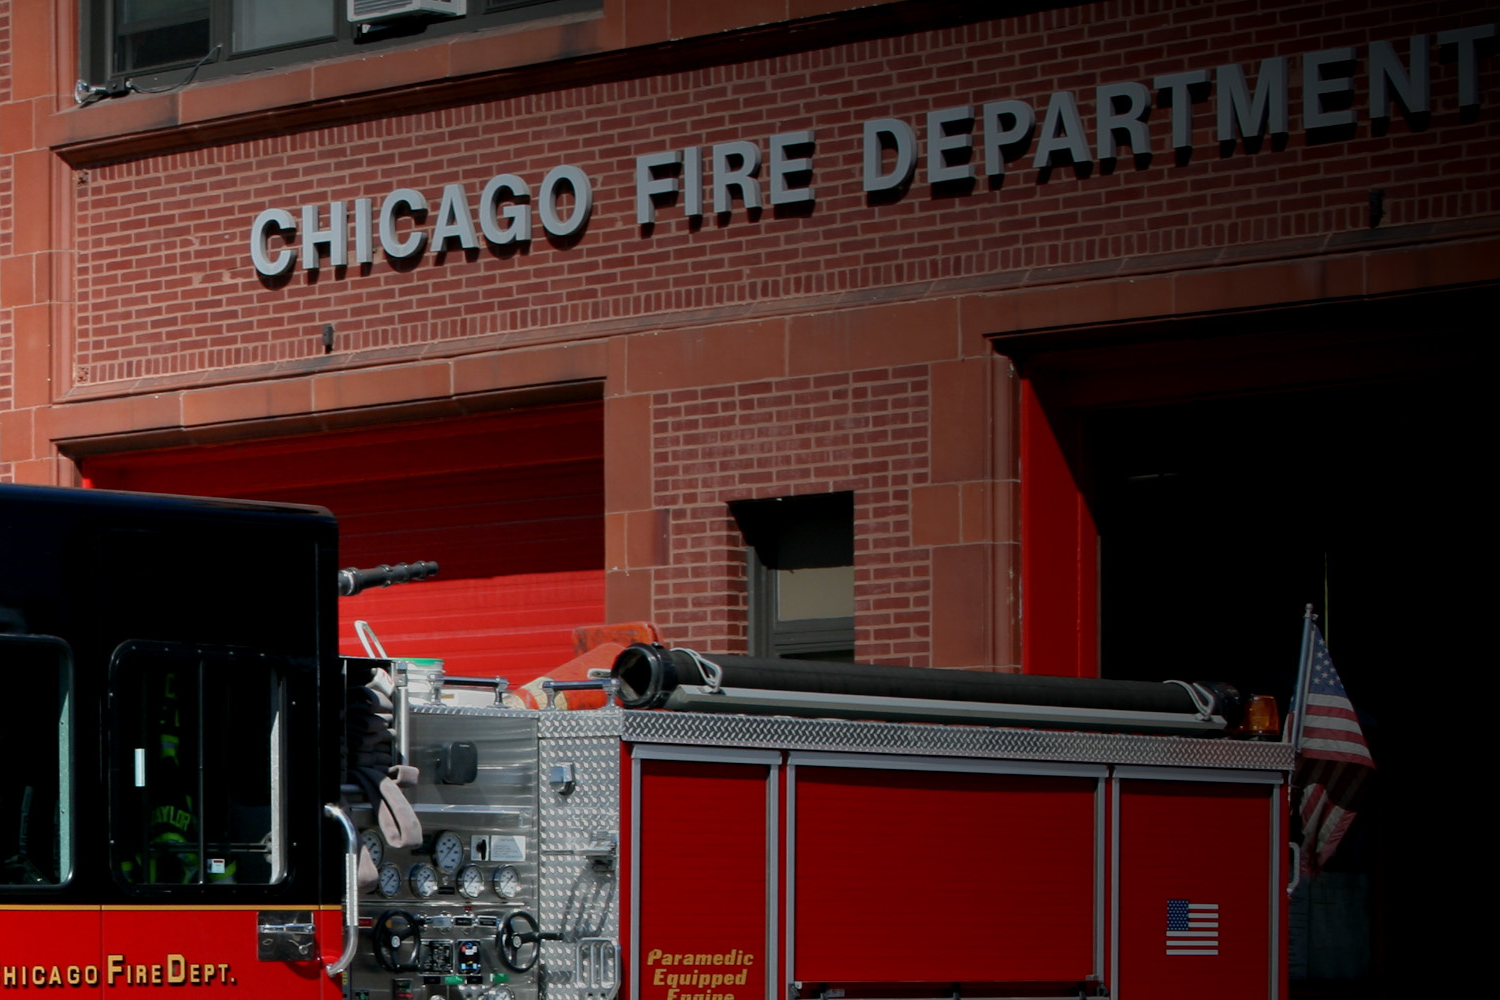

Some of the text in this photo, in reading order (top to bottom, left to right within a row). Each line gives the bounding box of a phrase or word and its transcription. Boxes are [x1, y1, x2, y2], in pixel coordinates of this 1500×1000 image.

[250, 24, 1498, 279] CHICAGO FIRE DEPARTMENT
[646, 948, 755, 967] Paramedic
[652, 968, 748, 988] Equipped
